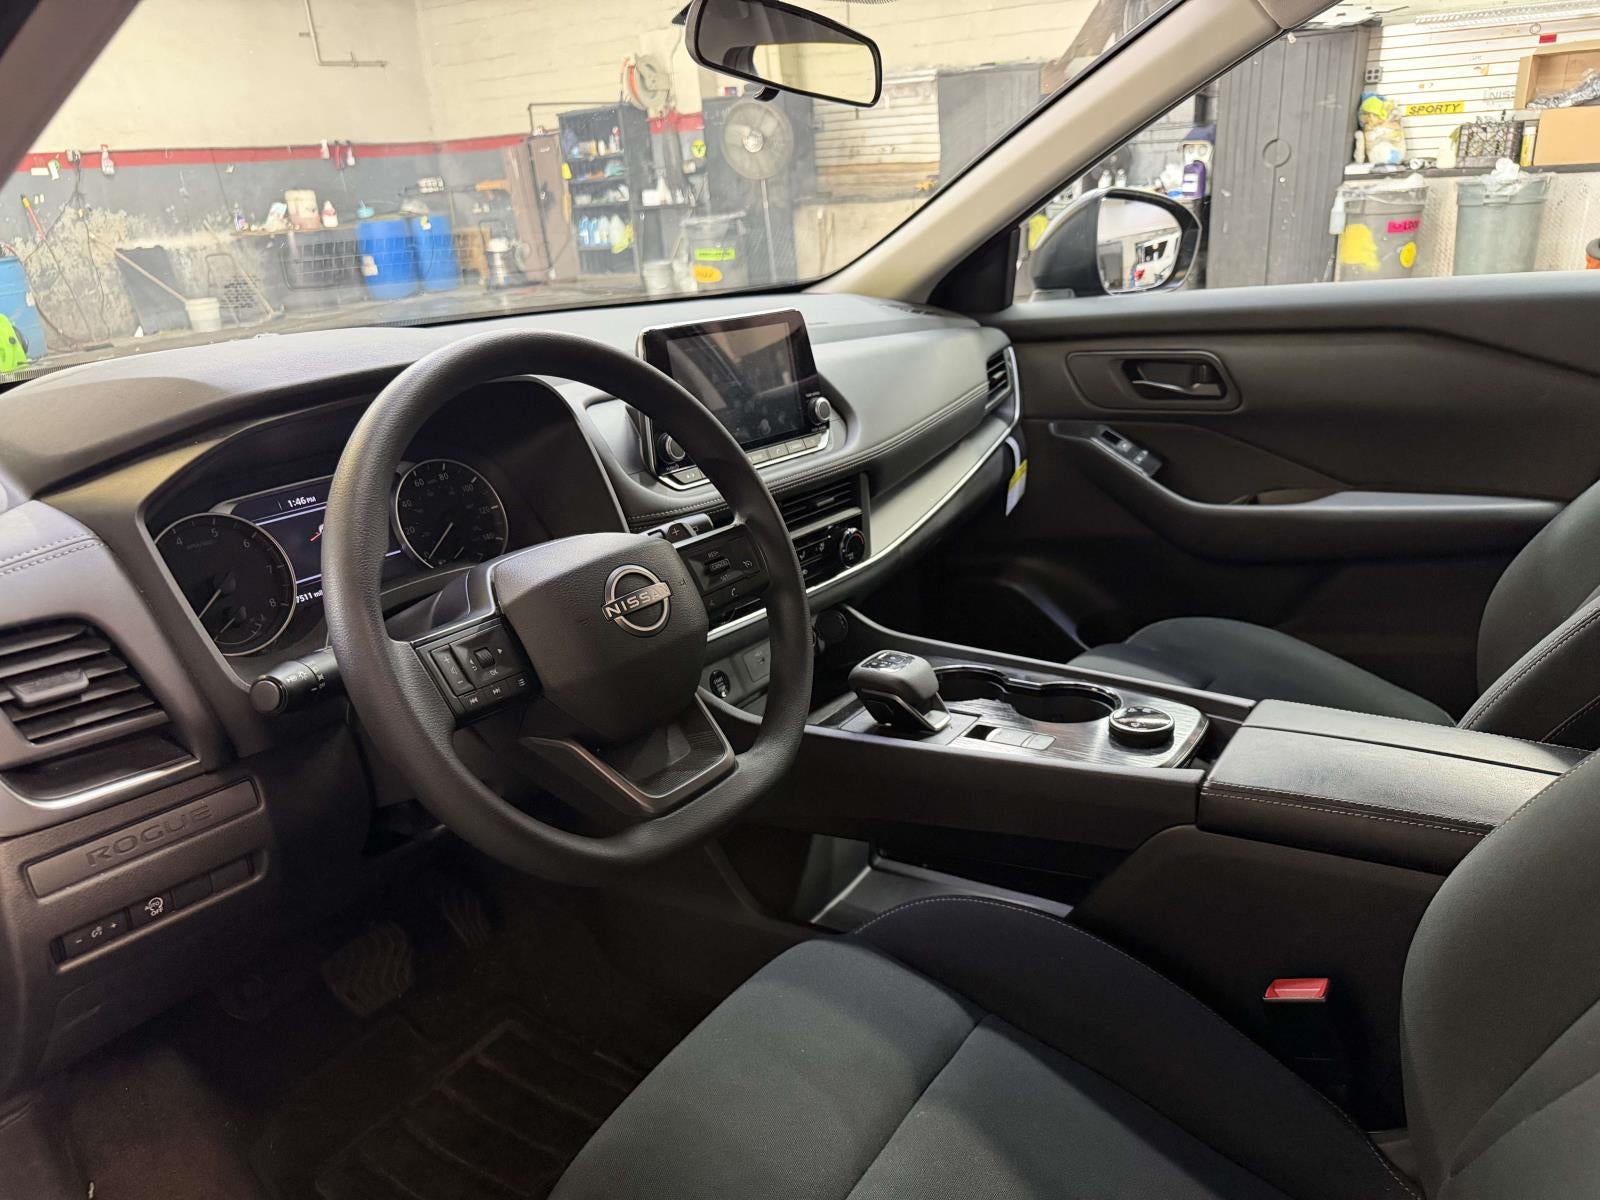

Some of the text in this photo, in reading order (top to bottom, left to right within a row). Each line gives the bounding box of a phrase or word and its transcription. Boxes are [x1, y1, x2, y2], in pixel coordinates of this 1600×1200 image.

[1409, 103, 1461, 115] SPORTY
[287, 495, 317, 508] 1:46 PM
[605, 586, 670, 617] NISSAN
[86, 804, 212, 866] ROGUE
